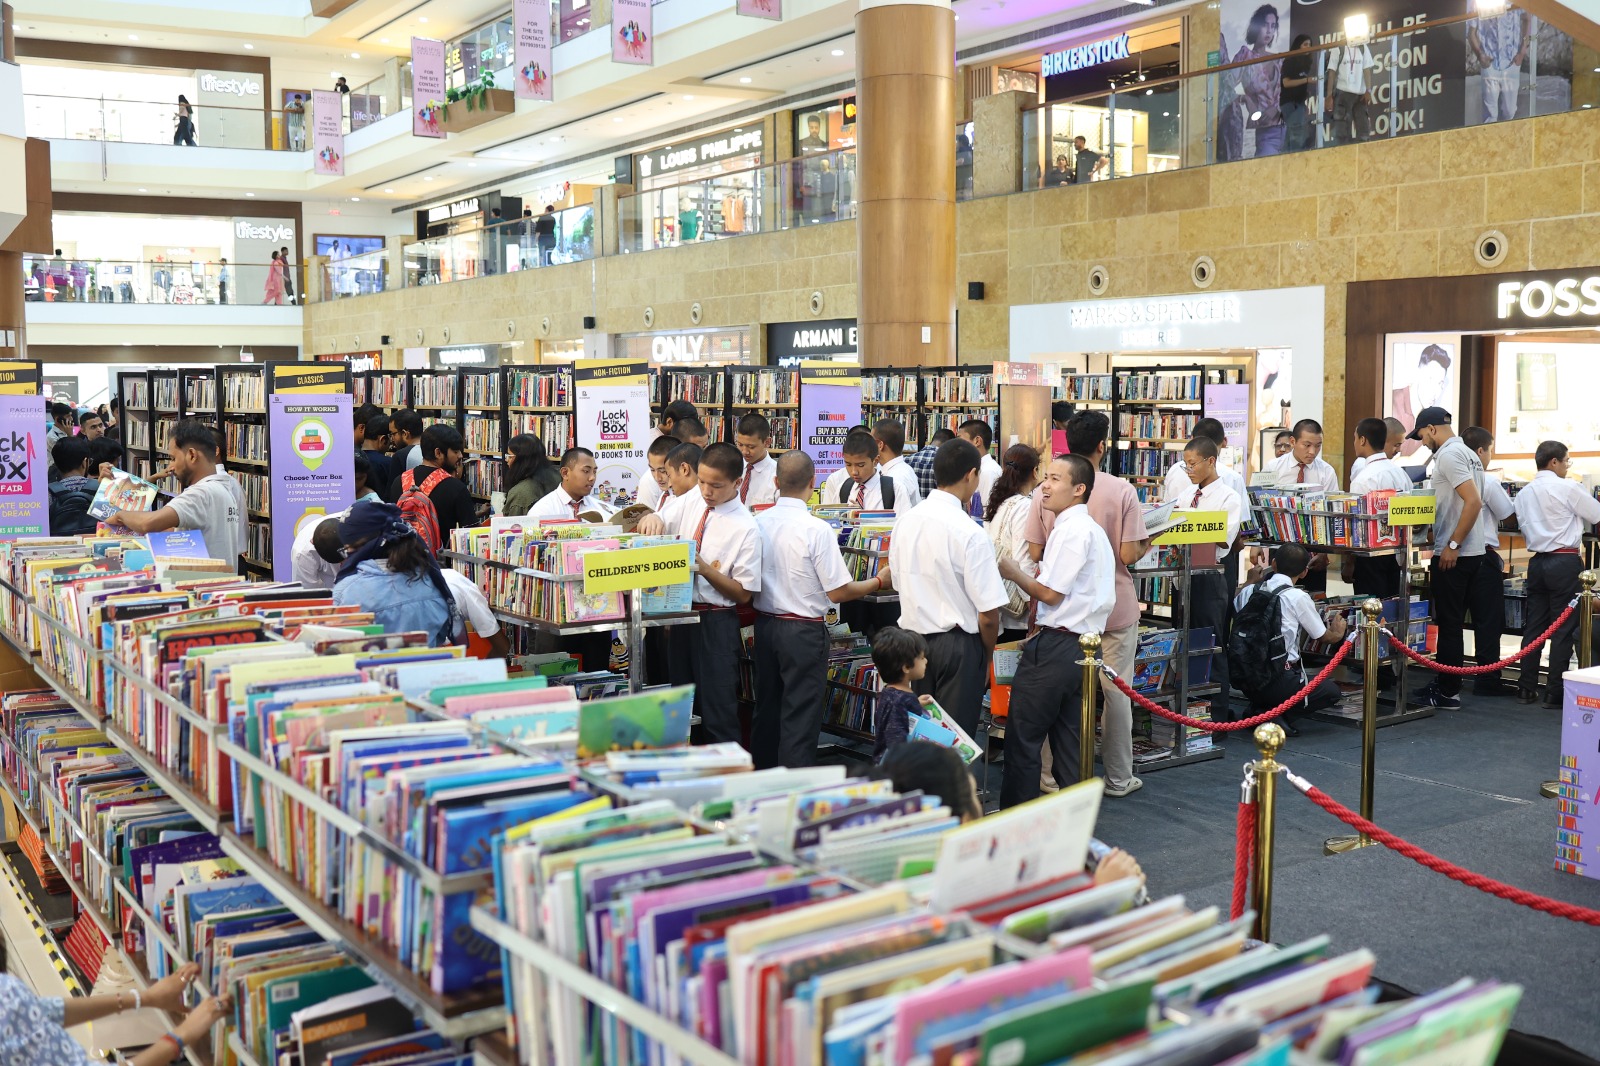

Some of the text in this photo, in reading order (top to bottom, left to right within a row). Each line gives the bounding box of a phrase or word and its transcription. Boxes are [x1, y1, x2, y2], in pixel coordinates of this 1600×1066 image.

[1041, 34, 1130, 78] BIRKENSTOCK
[200, 74, 260, 96] lifestyle
[660, 130, 762, 170] LOUIS PHILIPPE
[236, 221, 294, 242] lifestyle
[1497, 276, 1600, 318] FOSS
[792, 328, 842, 348] ARMANI
[652, 335, 704, 362] ONLY
[0, 372, 16, 382] TION
[594, 366, 631, 376] NON-FICTION
[297, 375, 324, 384] CLASSICS
[602, 409, 626, 420] Lock
[602, 421, 626, 433] Box
[1, 484, 23, 493] FAIR
[1391, 504, 1434, 514] COFFEE TABLE
[1196, 522, 1224, 532] TABLE
[588, 559, 686, 578] CHILDREN'S BOOKS
